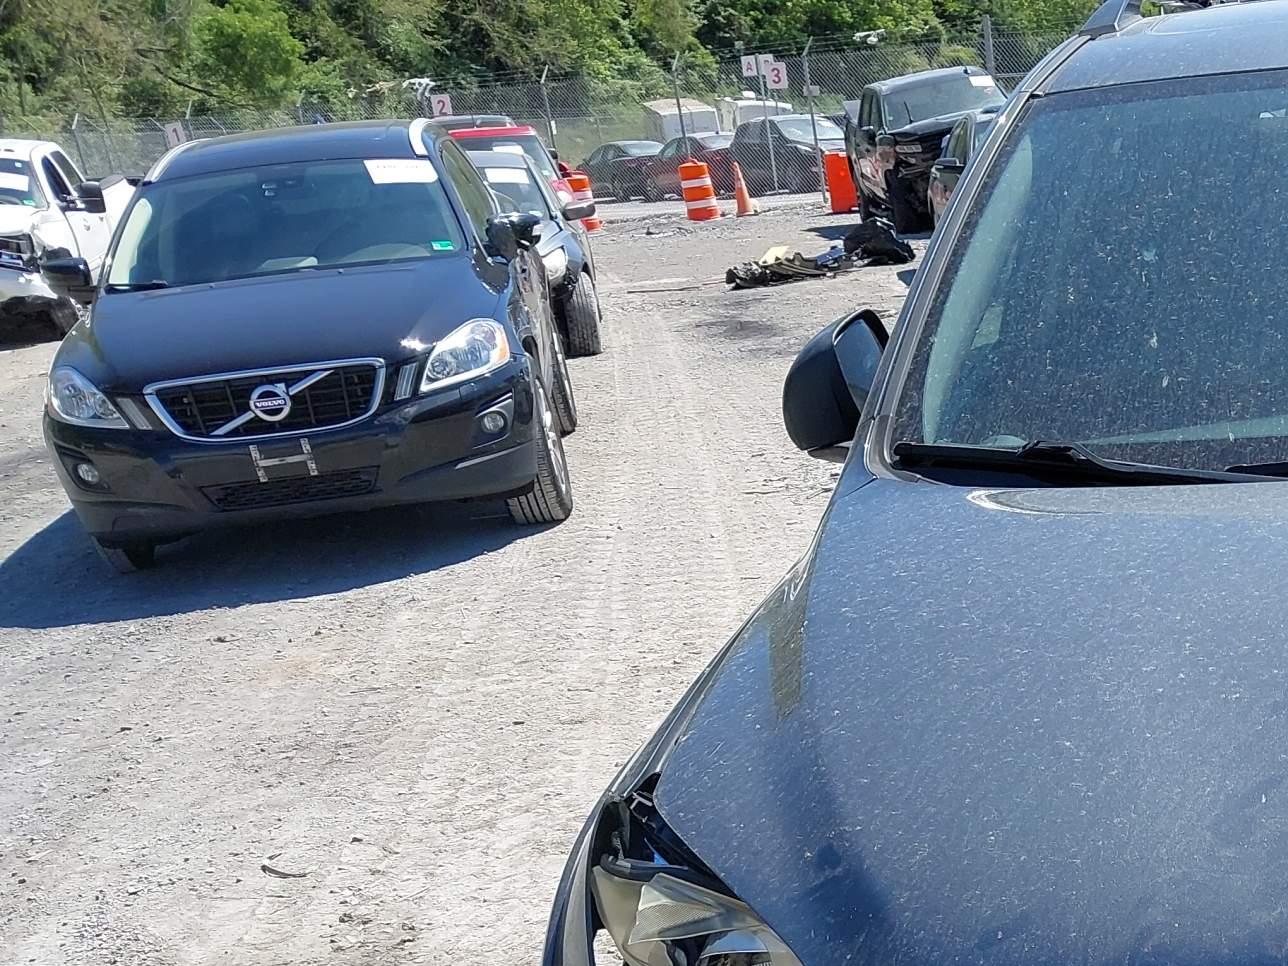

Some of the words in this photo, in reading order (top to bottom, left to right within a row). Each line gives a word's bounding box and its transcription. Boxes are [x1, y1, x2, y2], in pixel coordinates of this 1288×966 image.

[746, 61, 753, 72] A
[771, 67, 782, 85] 3
[436, 99, 448, 116] 2
[172, 127, 180, 142] 1
[255, 399, 286, 408] VOLVO
